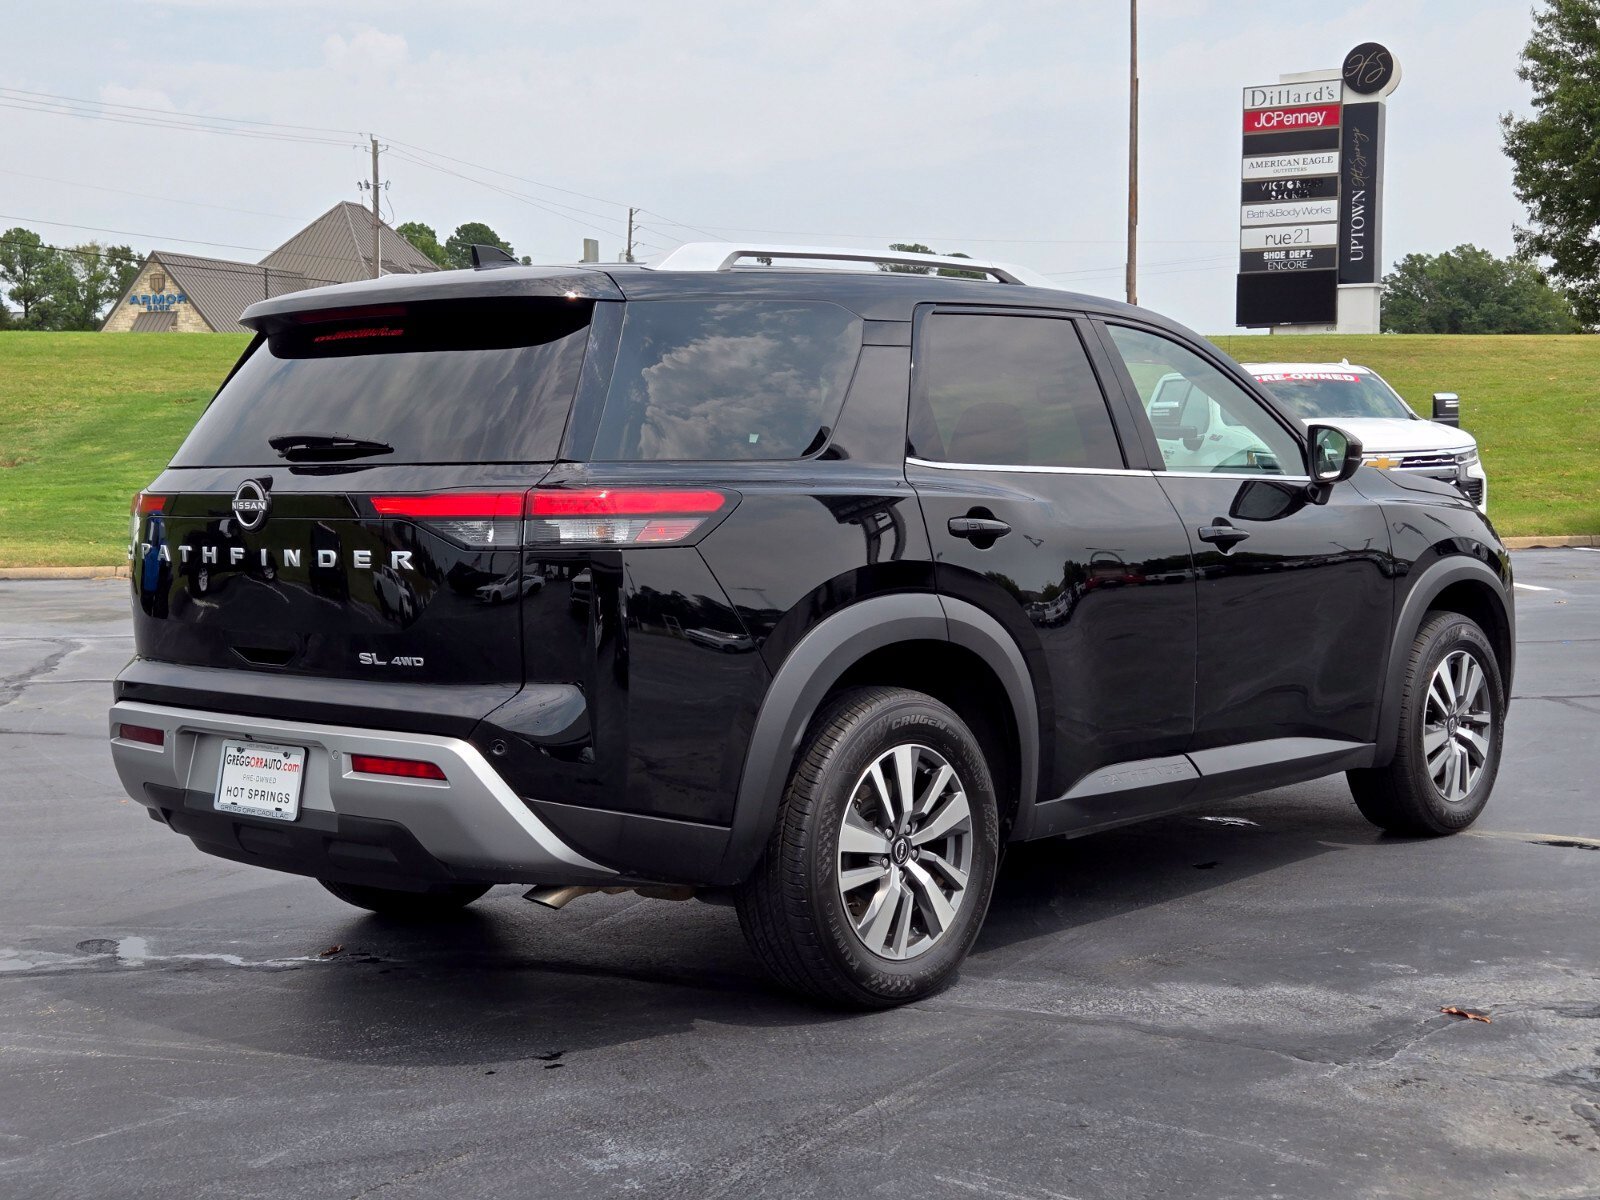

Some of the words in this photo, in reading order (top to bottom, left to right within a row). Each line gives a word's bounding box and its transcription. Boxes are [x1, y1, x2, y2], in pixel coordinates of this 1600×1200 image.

[1251, 86, 1335, 107] Dillard's
[1255, 111, 1327, 127] JCPenney
[1248, 158, 1300, 169] AMERICAN
[1302, 156, 1334, 166] EAGLE
[1350, 190, 1366, 262] UPTOWN
[1265, 228, 1312, 246] rue21
[1263, 251, 1286, 260] SHOE
[1289, 250, 1314, 259] DEPT.
[1267, 260, 1309, 271] ENCORE
[129, 294, 188, 305] ARMOR
[146, 304, 171, 312] BANK
[232, 501, 266, 511] NISSAN
[140, 542, 414, 571] PATHFINDER
[359, 652, 387, 666] SL
[391, 656, 424, 667] 4WD
[892, 714, 947, 731] CRUGEN
[226, 754, 299, 772] GREGGORRAUTO.com
[242, 774, 277, 784] PRE-OWNED
[226, 786, 245, 798] HOT
[248, 788, 290, 804] SPRINGS
[220, 803, 242, 813] GREGG
[242, 807, 257, 815] ORR
[256, 809, 290, 820] CADILLAC
